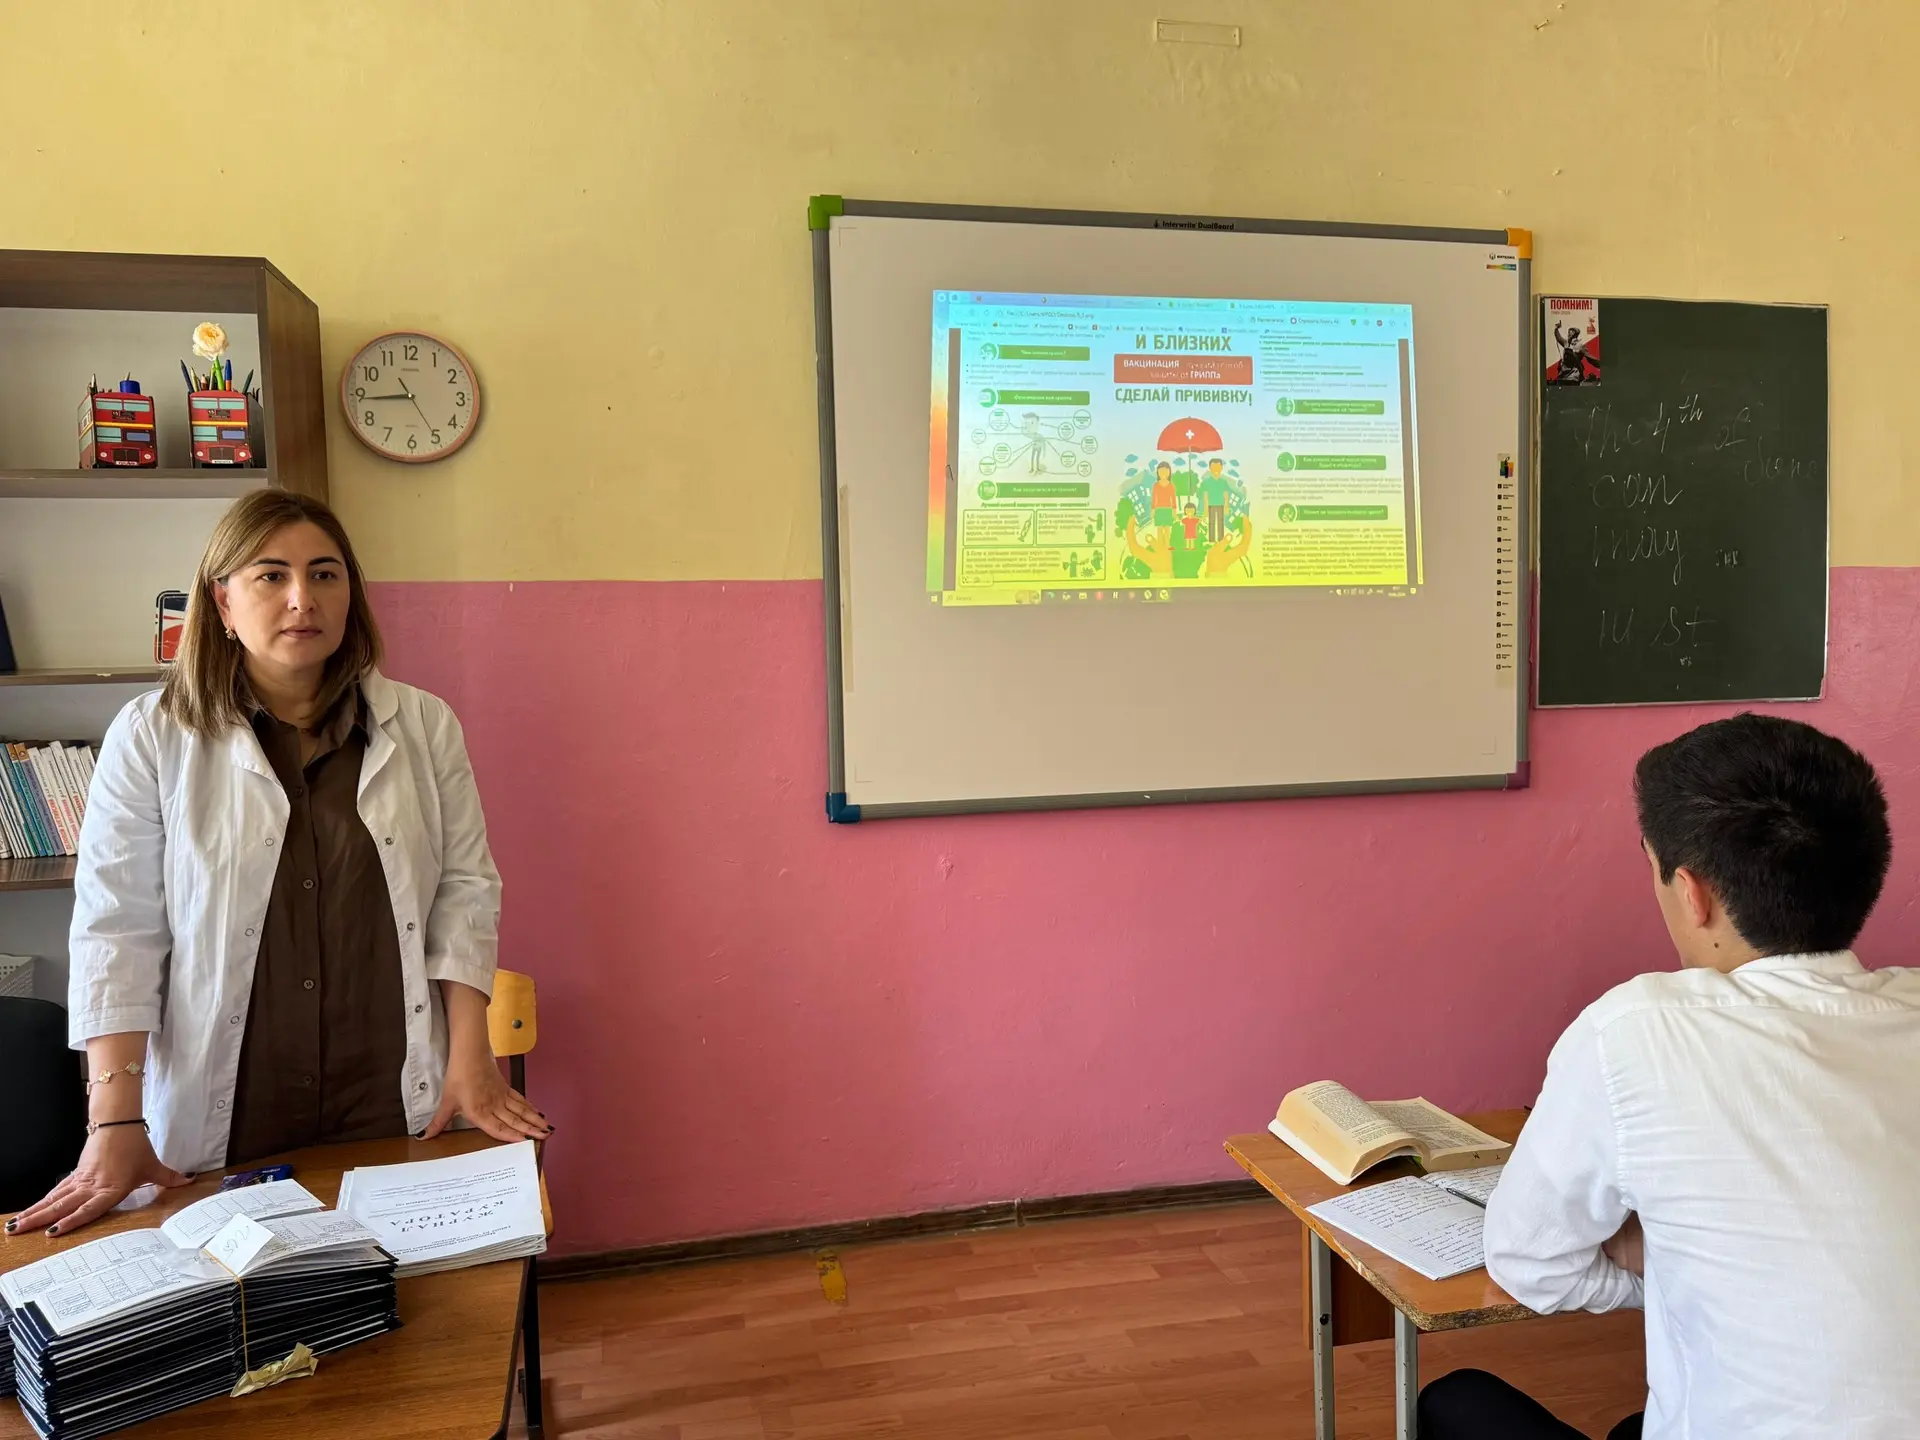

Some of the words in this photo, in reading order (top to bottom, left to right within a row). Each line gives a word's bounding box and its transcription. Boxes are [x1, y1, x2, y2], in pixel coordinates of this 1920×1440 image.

[1198, 221, 1235, 230] DualBoard
[1550, 299, 1593, 310] ПОМНИМ!
[1135, 334, 1147, 349] И
[1153, 334, 1232, 351] БЛИЗКИХ
[381, 350, 393, 366] 11
[403, 345, 418, 360] 12
[432, 352, 437, 367] 1
[1123, 359, 1180, 369] ВАКЦИНАЦИЯ
[363, 366, 379, 381] 10
[447, 368, 457, 384] 2
[355, 387, 366, 402] 9
[455, 391, 466, 407] 3
[1115, 386, 1170, 404] СДЕЛАЙ
[1175, 389, 1252, 406] ПРИВИВКУ!
[364, 411, 375, 426] 8
[447, 413, 458, 429] 4
[383, 426, 393, 442] 7
[407, 434, 417, 449] 6
[430, 429, 441, 444] 5
[389, 1200, 505, 1227] КУРАТОРА
[400, 1210, 494, 1233] ЖУРНАЛ
